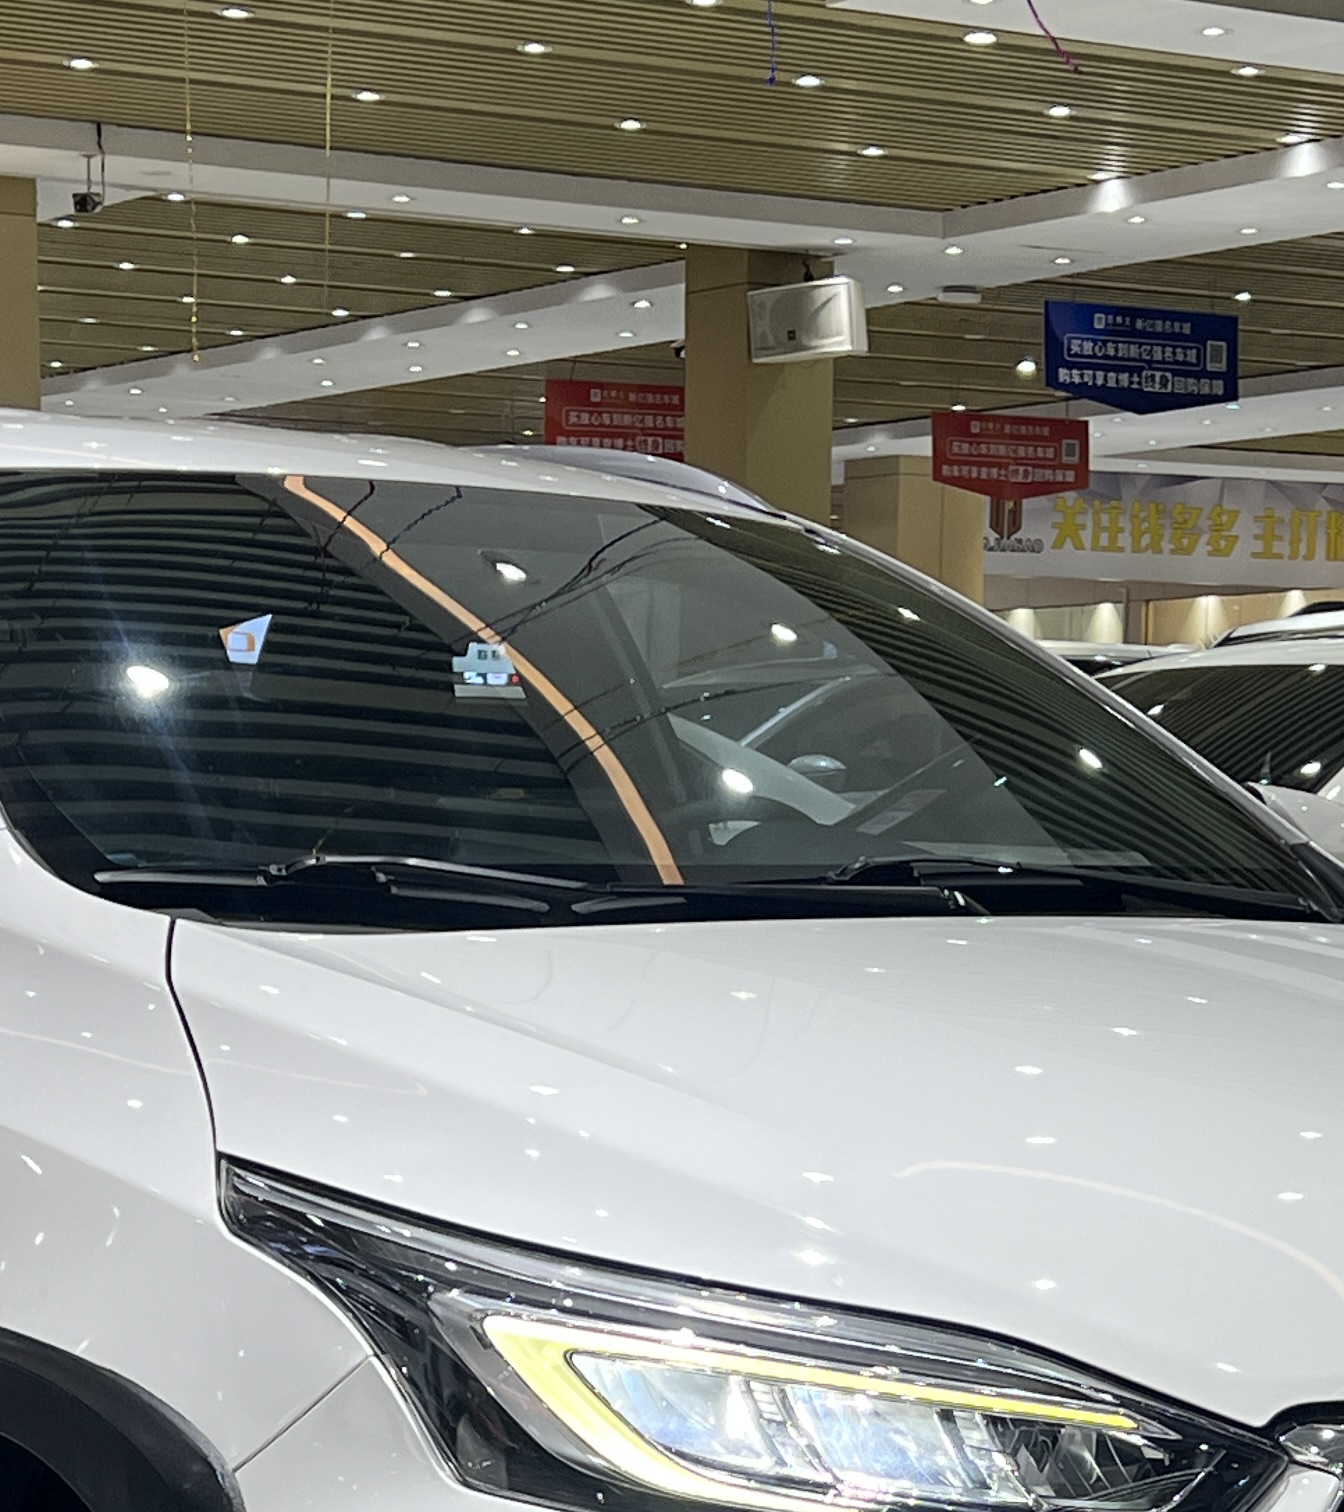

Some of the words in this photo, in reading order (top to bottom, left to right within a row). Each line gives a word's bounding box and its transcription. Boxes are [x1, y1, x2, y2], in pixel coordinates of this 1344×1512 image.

[1050, 496, 1242, 558] 关注钱多多
